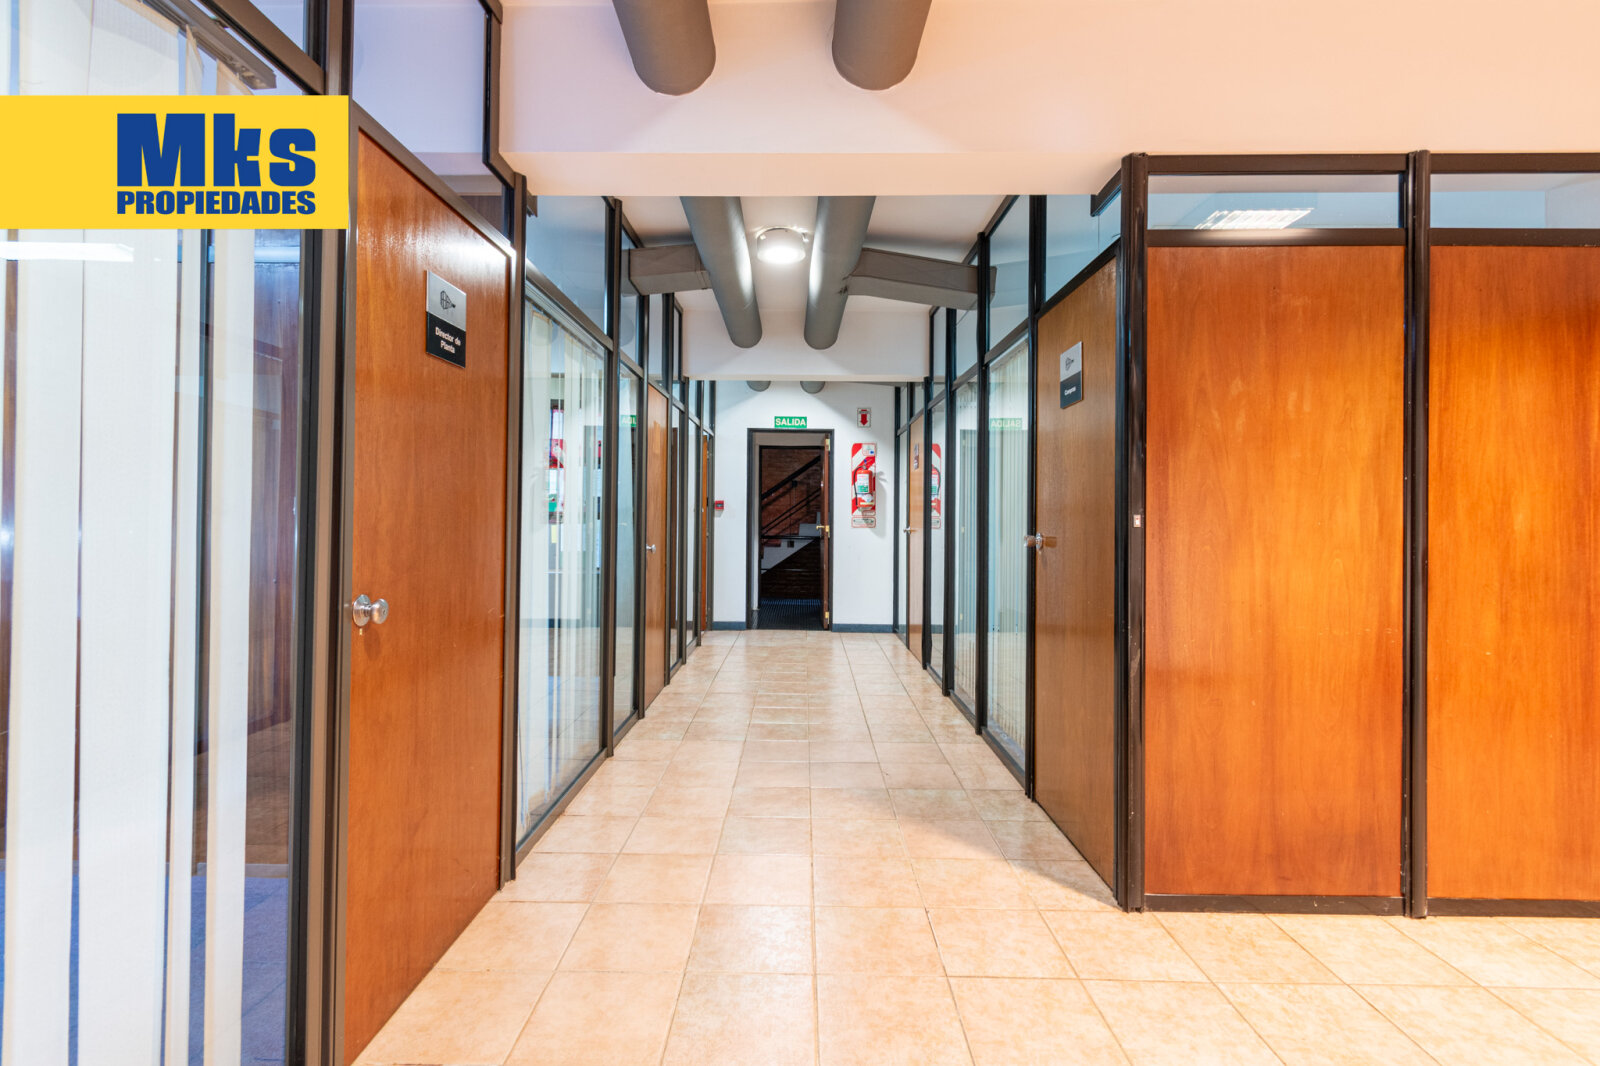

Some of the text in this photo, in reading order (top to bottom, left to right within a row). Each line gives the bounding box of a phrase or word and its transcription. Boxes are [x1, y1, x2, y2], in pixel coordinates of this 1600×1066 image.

[435, 326, 462, 347] Director de
[440, 340, 455, 354] Planta
[775, 418, 806, 426] SALIDA
